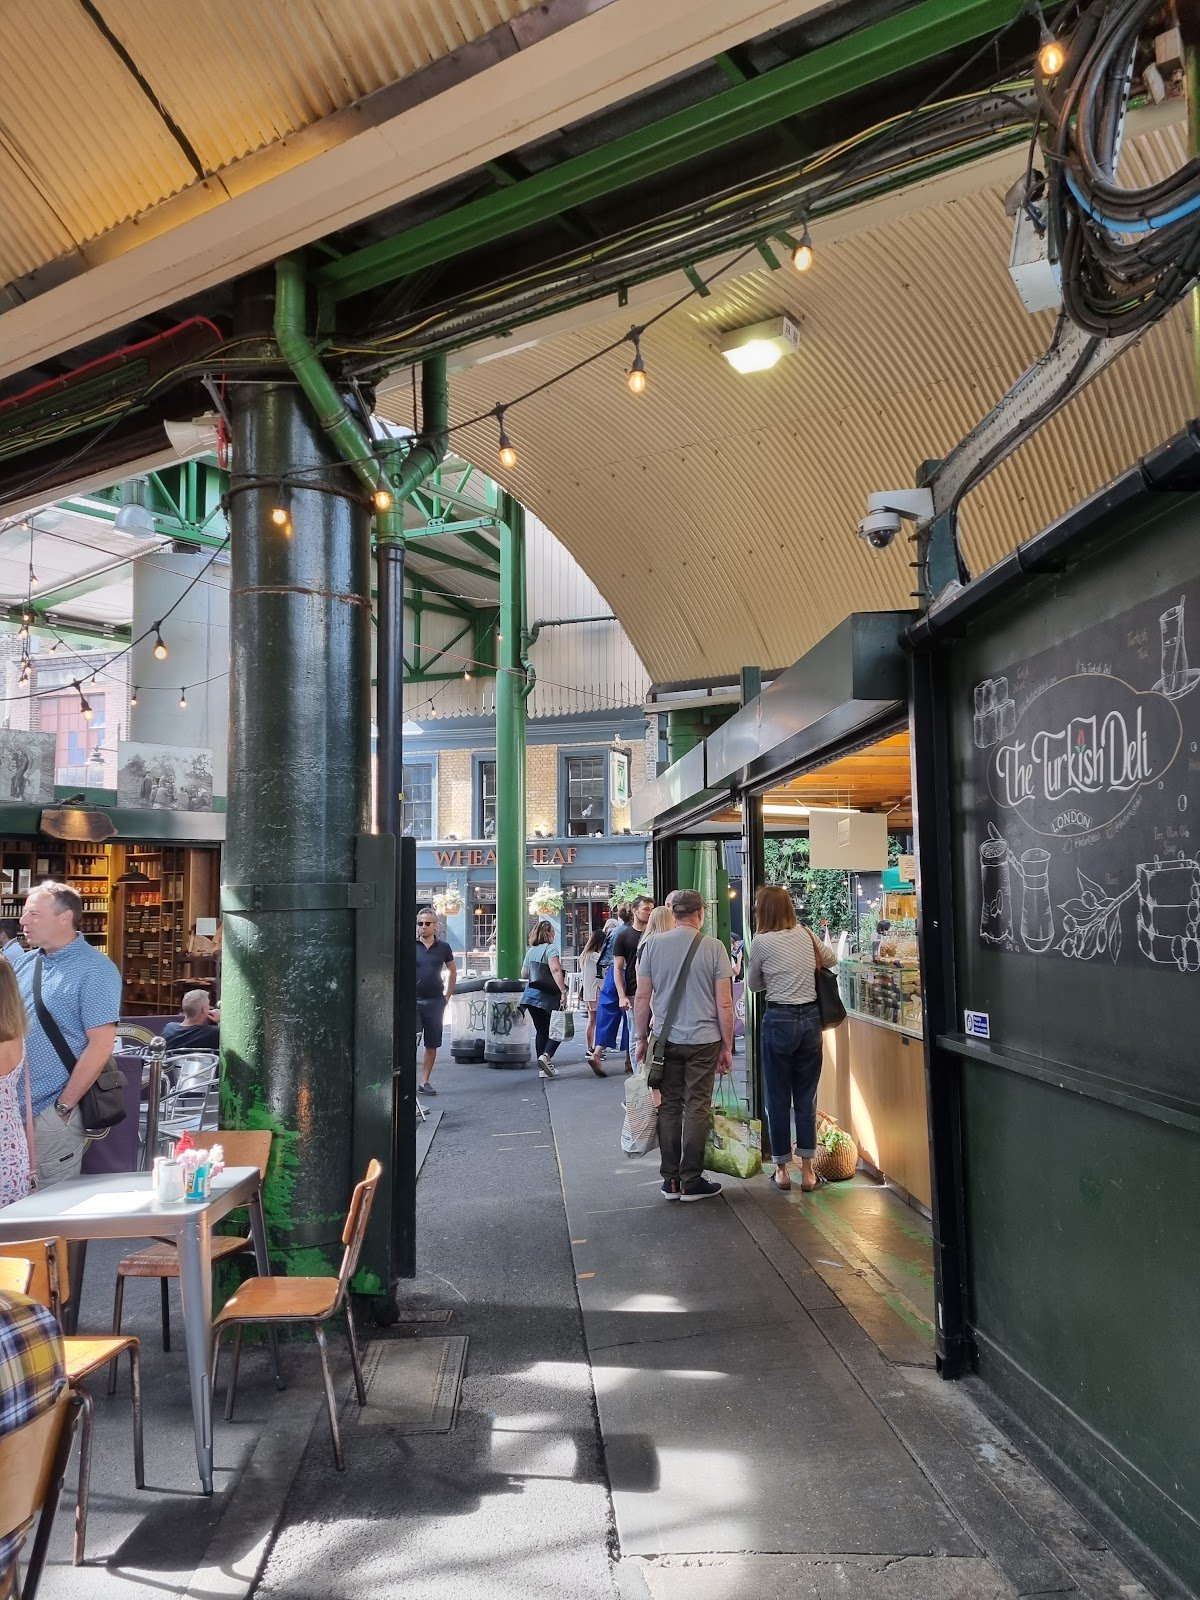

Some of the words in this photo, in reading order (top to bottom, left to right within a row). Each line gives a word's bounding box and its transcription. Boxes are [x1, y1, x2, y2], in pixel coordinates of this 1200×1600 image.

[995, 740, 1036, 806] The
[1031, 715, 1104, 801] Turkish
[1100, 706, 1153, 793] Deli
[1051, 810, 1091, 834] LONDON
[433, 847, 579, 867] WHEAHEAF
